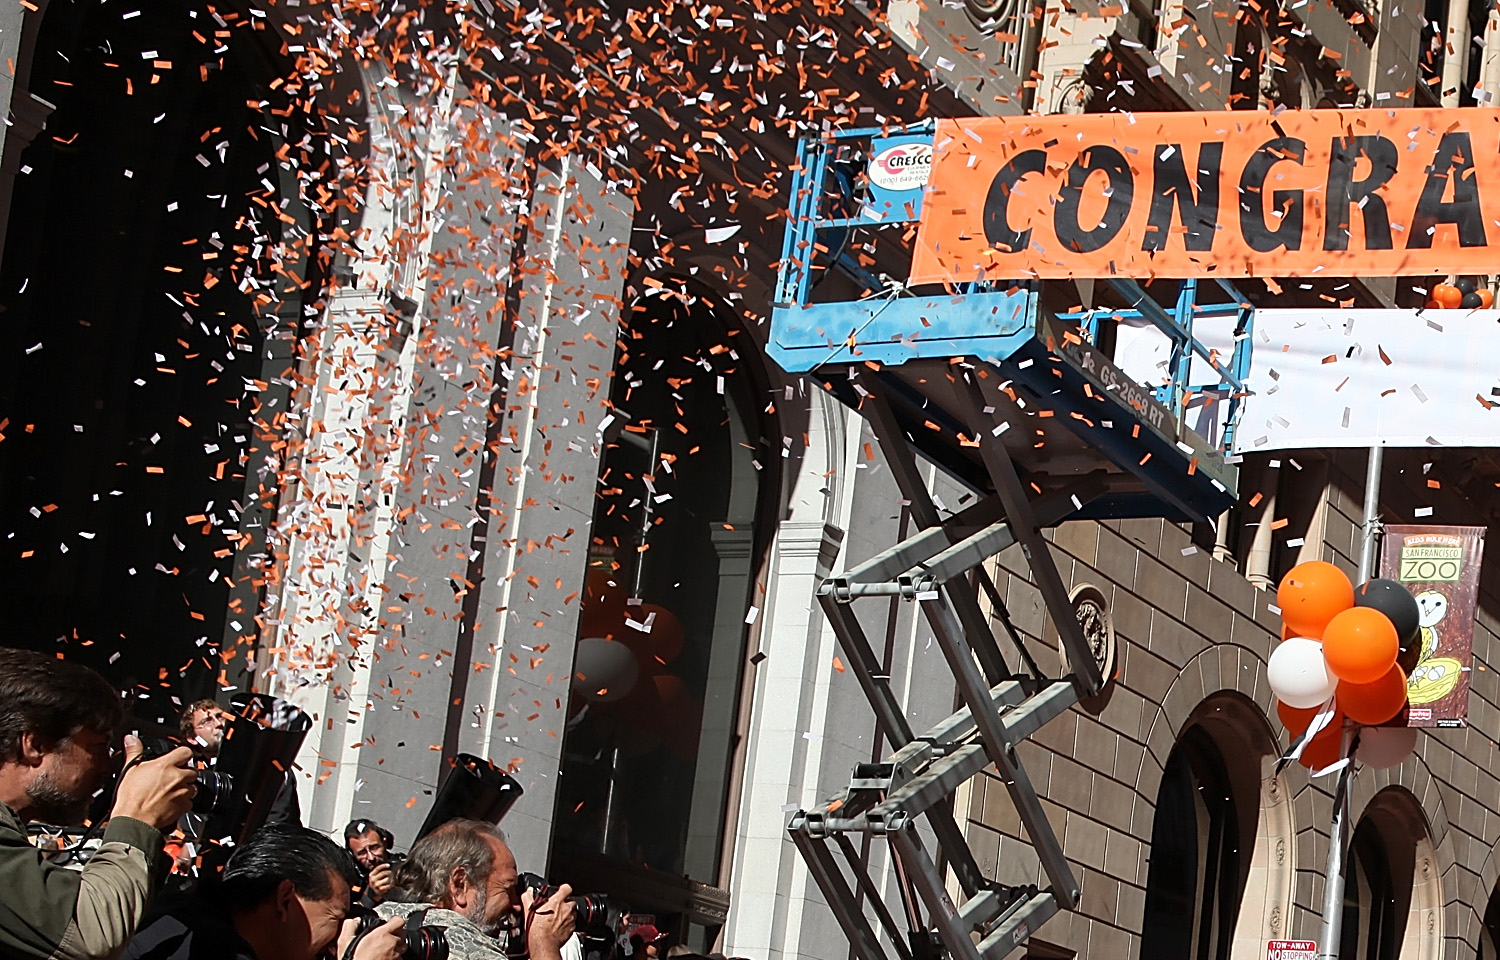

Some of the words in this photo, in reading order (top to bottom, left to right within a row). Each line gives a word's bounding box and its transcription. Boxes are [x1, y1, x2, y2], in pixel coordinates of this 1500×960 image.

[1149, 403, 1165, 429] RT
[1405, 549, 1420, 557] SAN
[1421, 549, 1459, 557] FRANCISCO
[1403, 561, 1457, 579] ZOO
[1272, 942, 1311, 950] TOW-AWAY
[1268, 949, 1281, 960] NO
[1282, 951, 1313, 960] STOPPING
